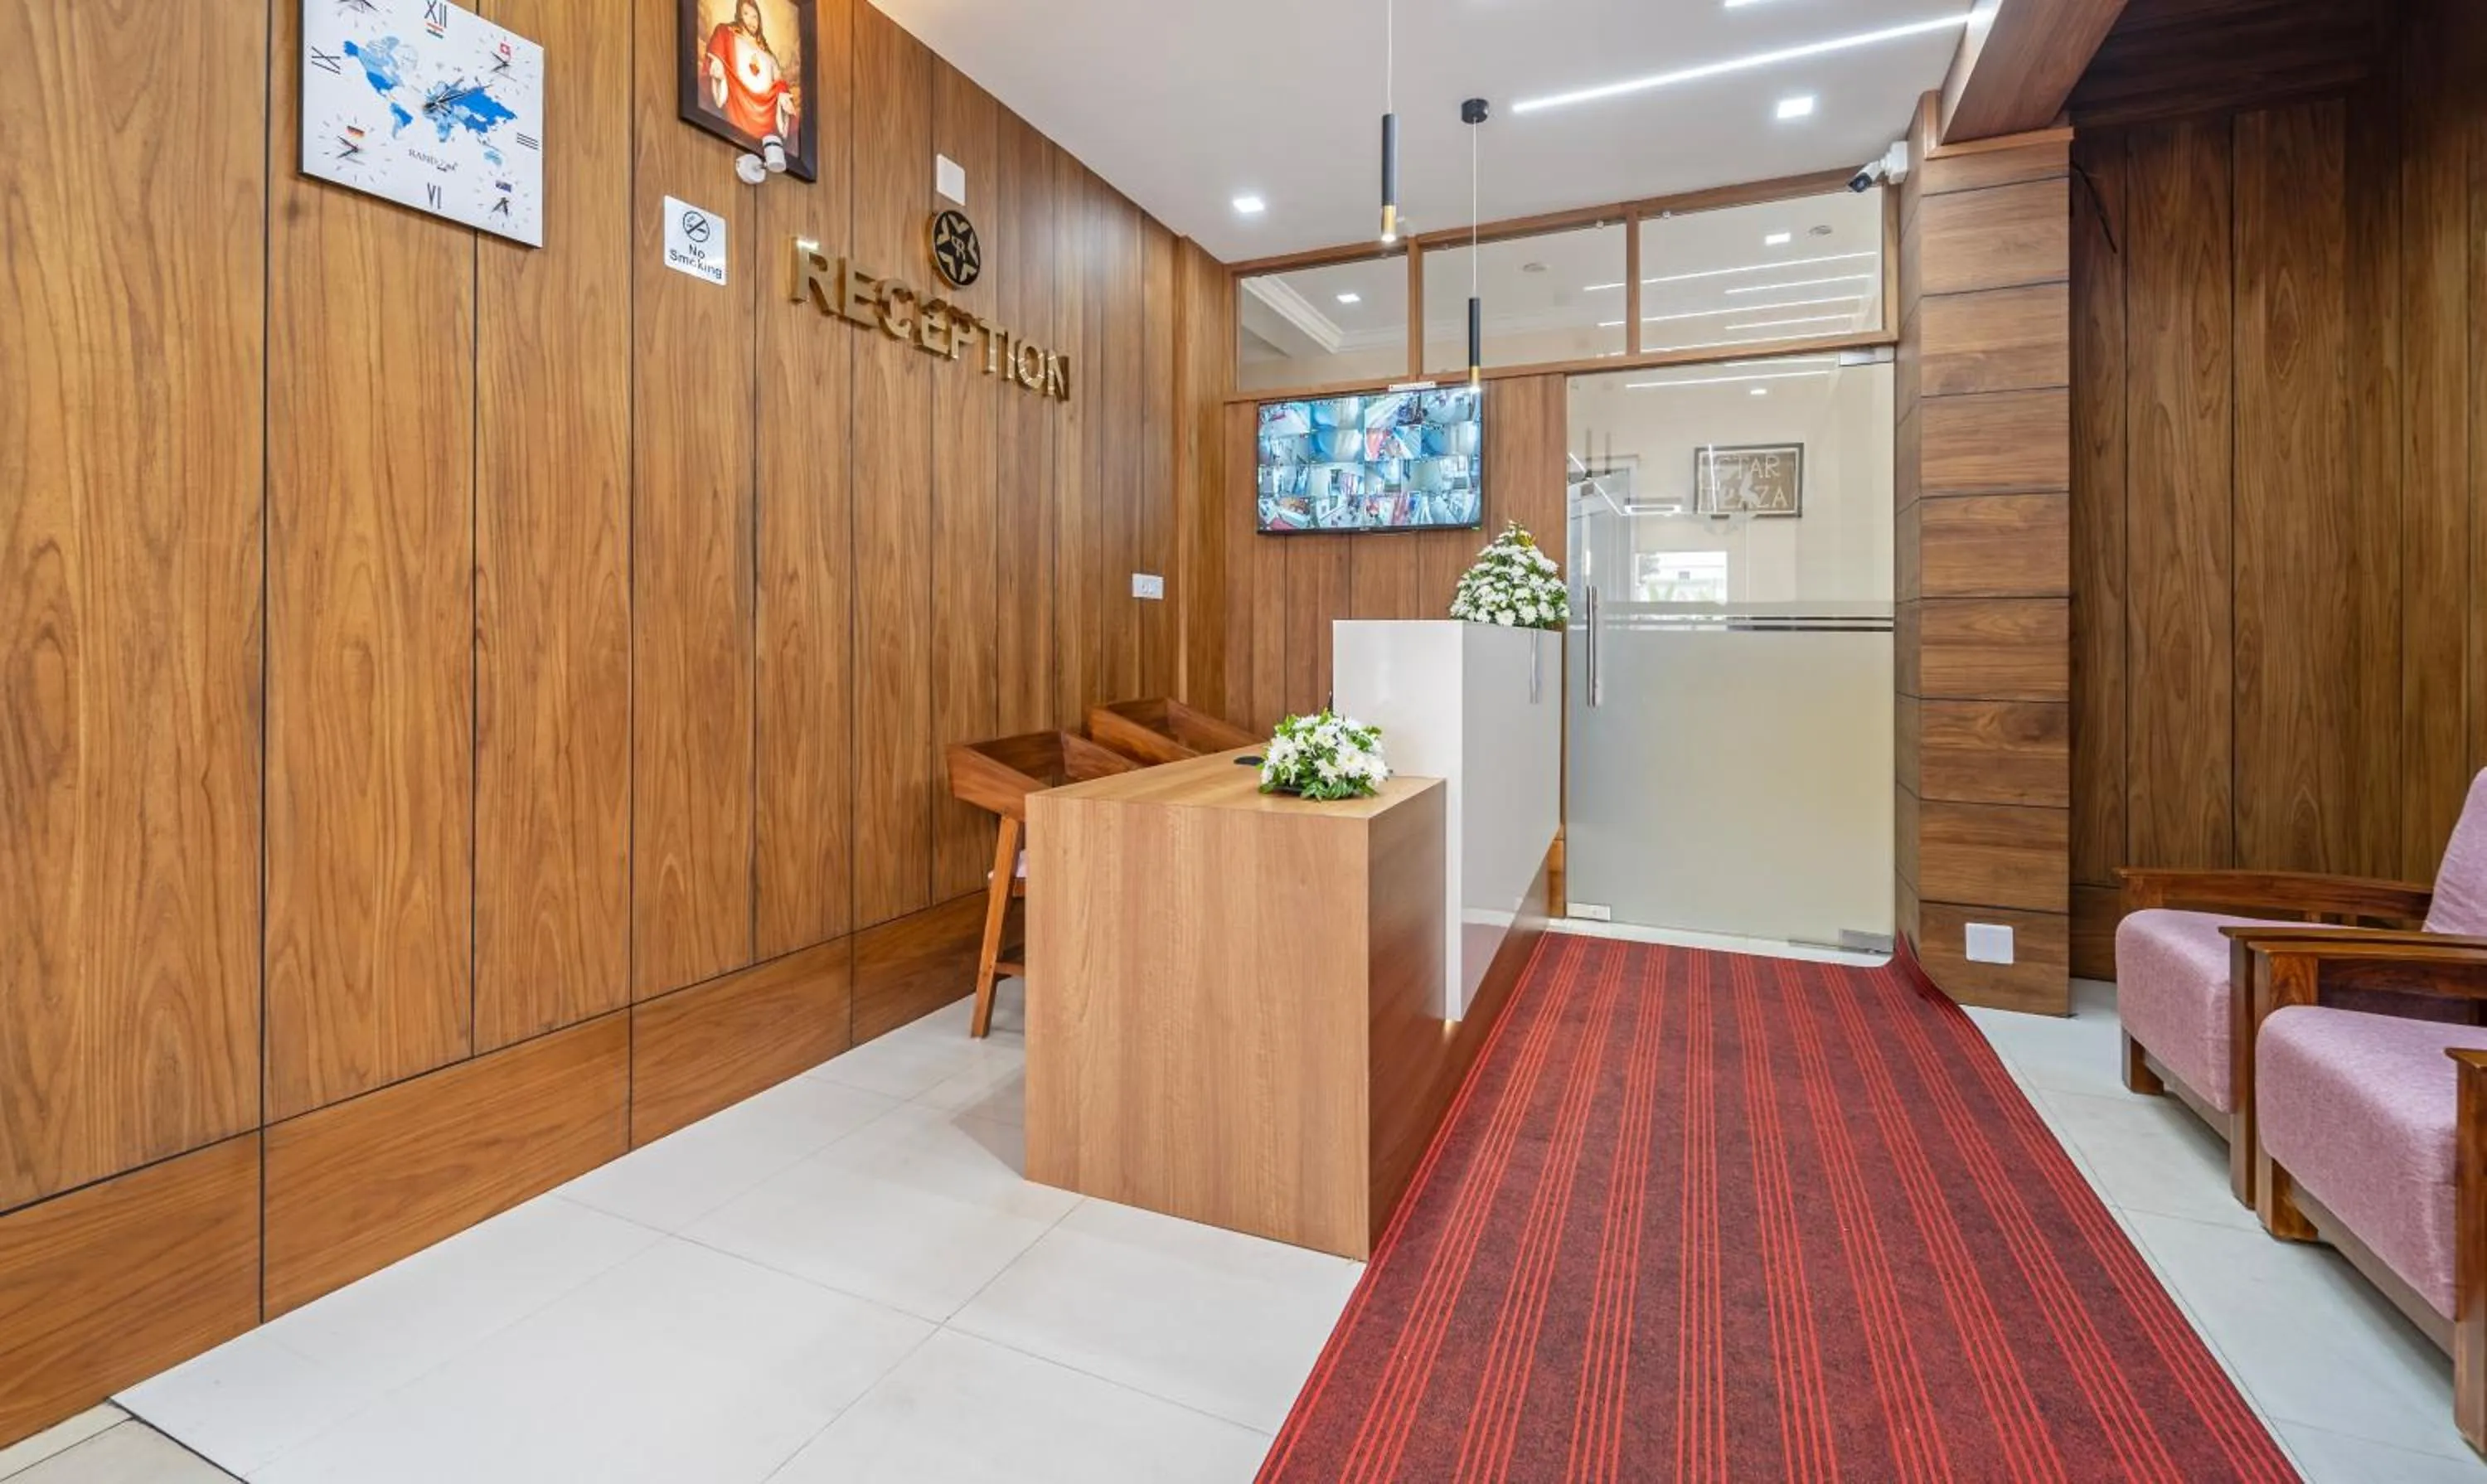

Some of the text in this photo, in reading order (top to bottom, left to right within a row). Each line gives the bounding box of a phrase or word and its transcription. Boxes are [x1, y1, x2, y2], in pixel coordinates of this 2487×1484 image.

[424, 0, 447, 28] XII
[427, 182, 441, 209] VI
[669, 249, 722, 279] Smoking
[689, 244, 705, 259] No
[792, 237, 1069, 403] RECEPTION
